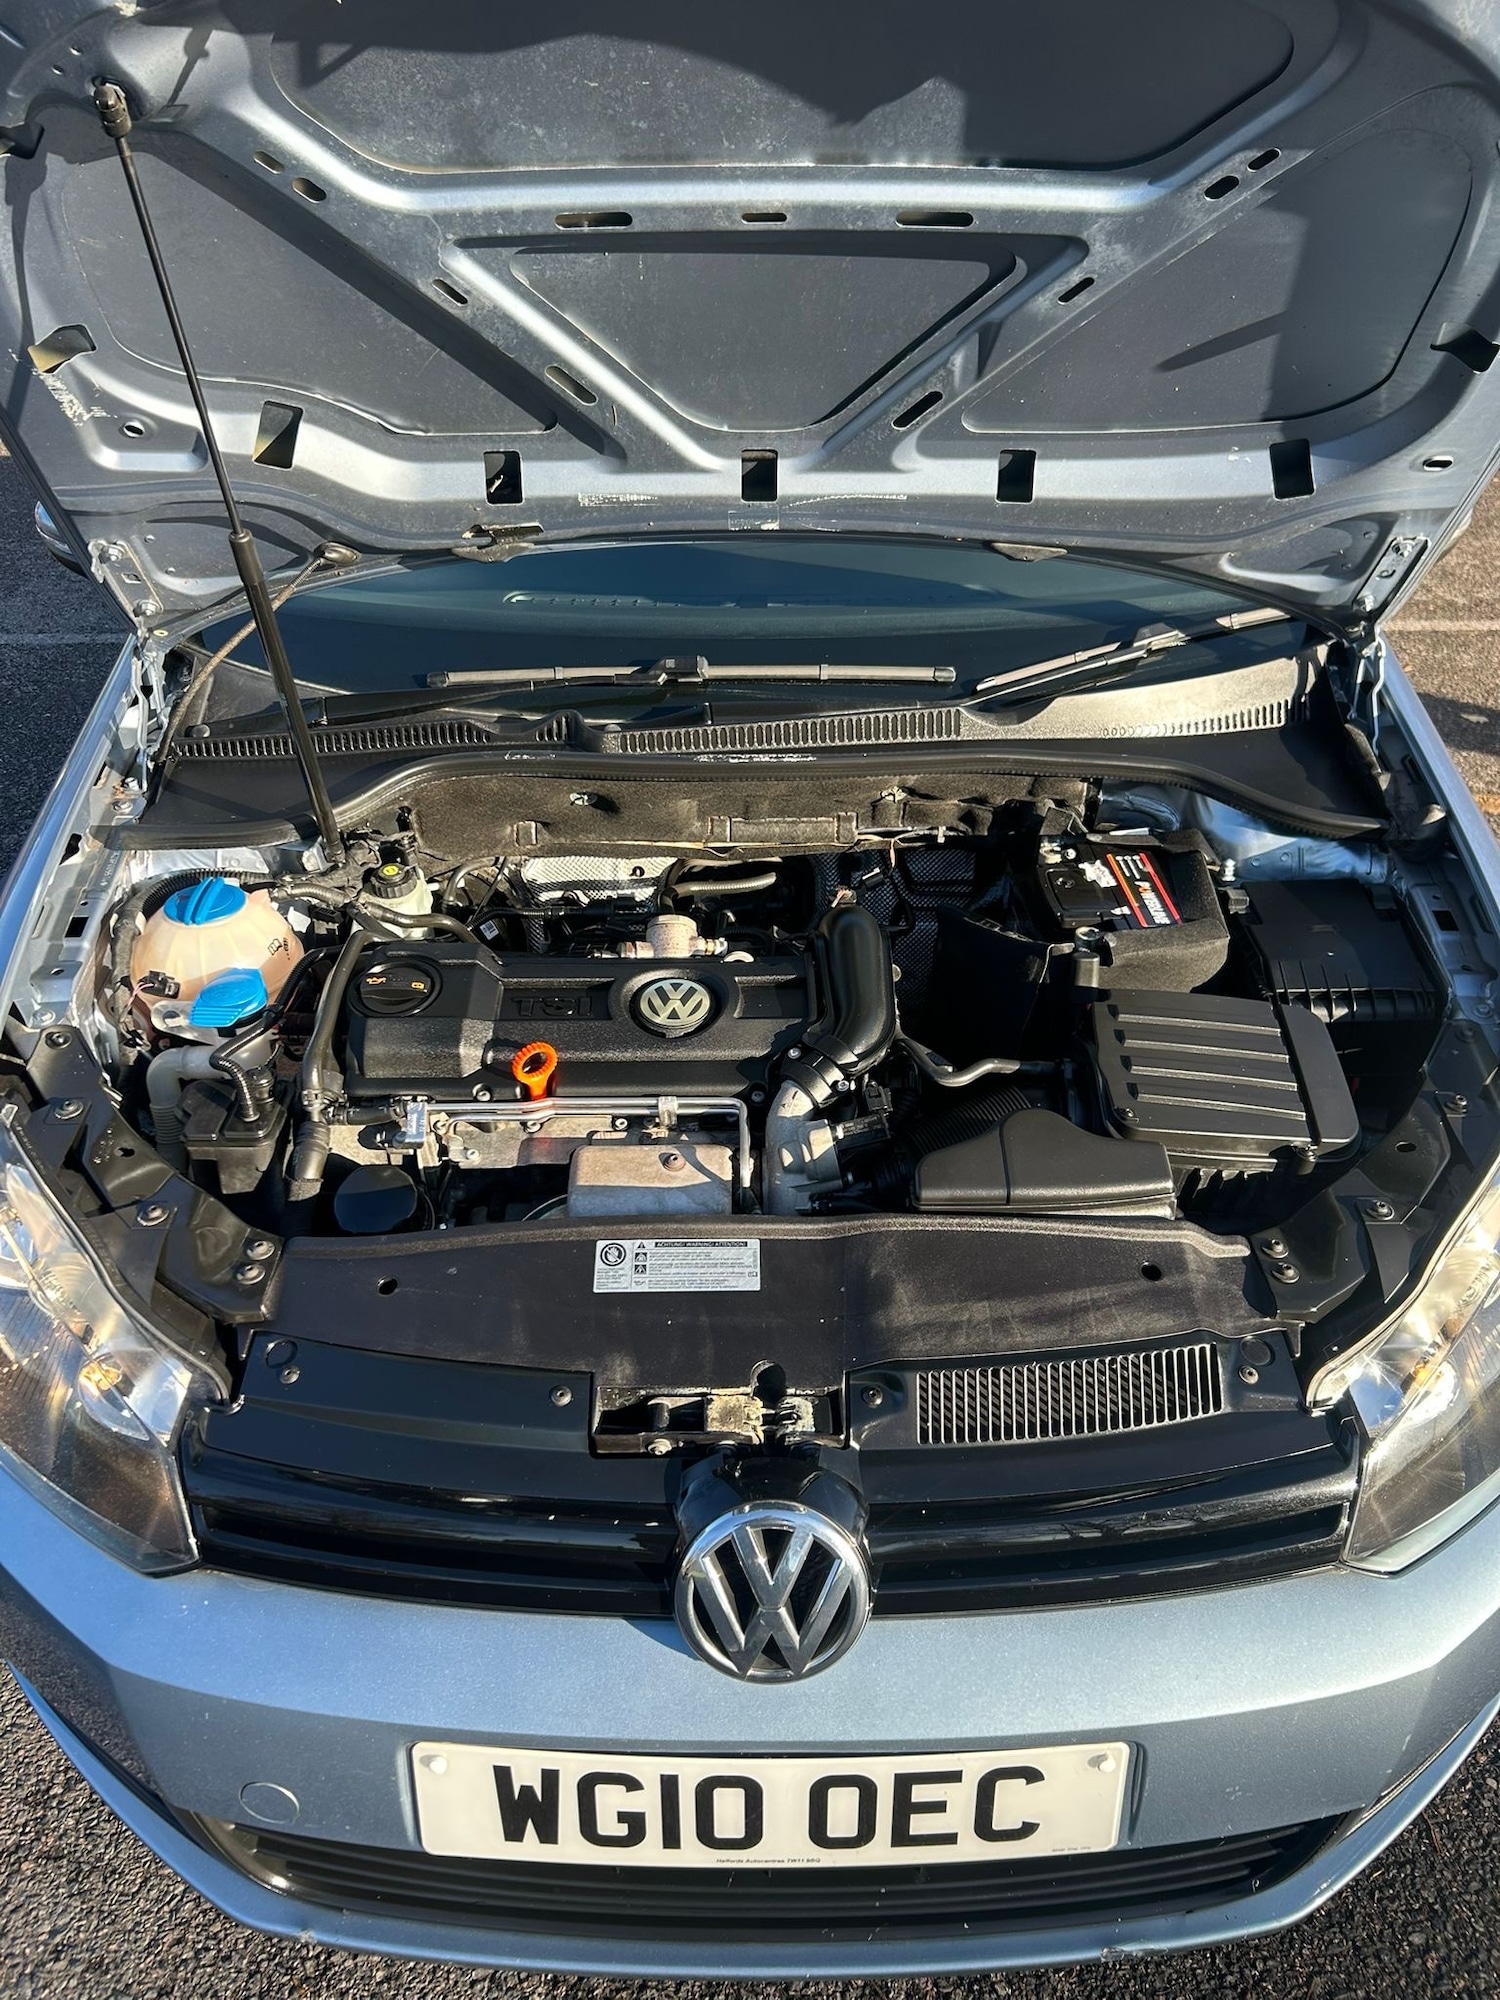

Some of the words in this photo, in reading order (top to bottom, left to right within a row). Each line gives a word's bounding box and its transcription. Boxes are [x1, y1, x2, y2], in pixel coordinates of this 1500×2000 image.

[511, 996, 592, 1017] TSI
[492, 1765, 764, 1850] WG10
[808, 1765, 1045, 1849] OEC
